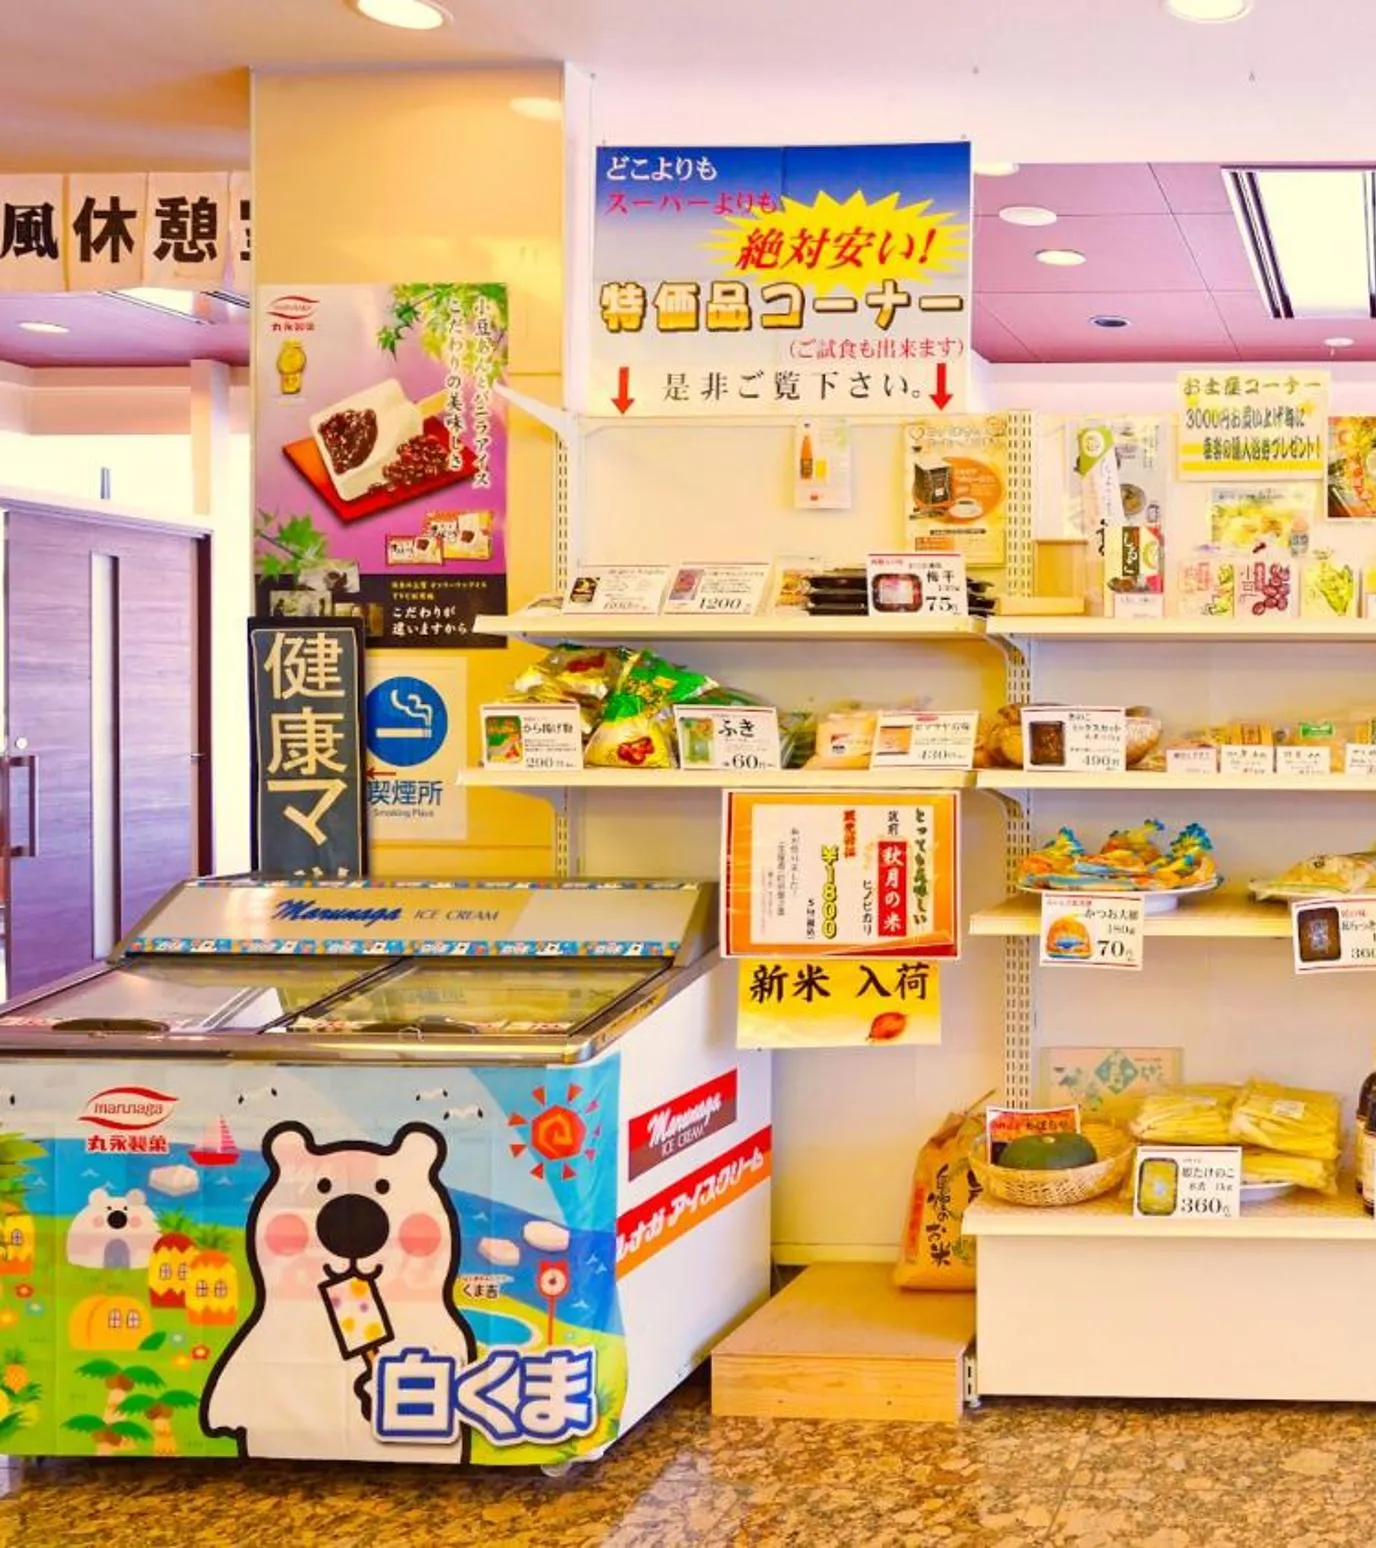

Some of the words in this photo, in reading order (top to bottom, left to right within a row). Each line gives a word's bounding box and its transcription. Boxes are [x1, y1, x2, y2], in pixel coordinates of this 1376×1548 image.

[606, 156, 718, 181] どこよりも
[605, 190, 777, 215] スーパーよりも
[735, 228, 936, 270] 絶対安い!
[600, 280, 964, 332] 特価品コーナー
[663, 371, 921, 402] 是非ご覧下さい。
[718, 718, 756, 738] ふき
[264, 631, 348, 878] 健康マ
[884, 846, 902, 933] 秋月の米
[272, 899, 402, 926] Marunaga
[414, 908, 441, 921] ICE
[446, 909, 499, 922] CREAM
[750, 964, 831, 1004] 新米
[855, 962, 930, 1001] 入荷
[88, 1134, 168, 1153] 丸永製菓
[375, 1347, 597, 1441] 白くま
